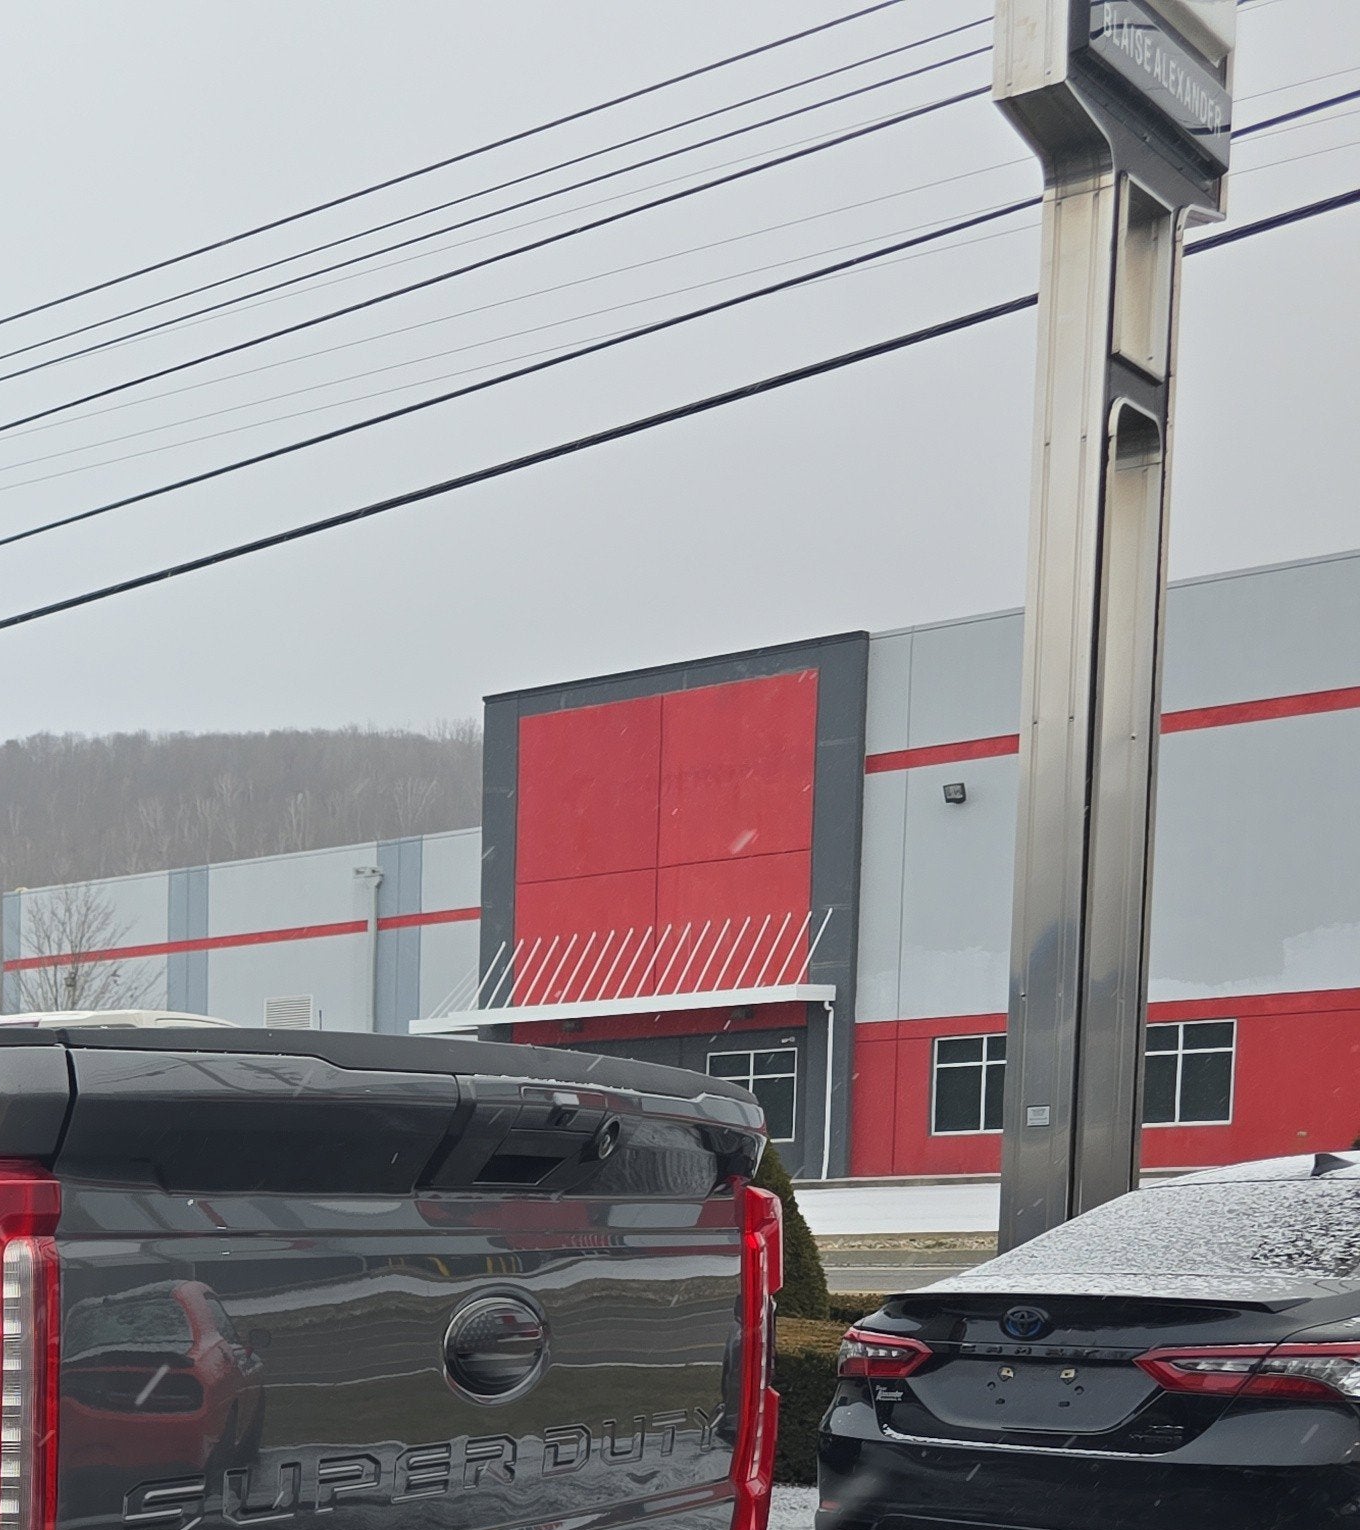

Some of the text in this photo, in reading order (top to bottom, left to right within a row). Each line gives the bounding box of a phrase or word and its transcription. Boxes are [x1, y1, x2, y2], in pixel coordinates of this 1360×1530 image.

[1103, 1, 1222, 139] BLAISE ALEXANDER
[541, 1402, 727, 1479] DUTY
